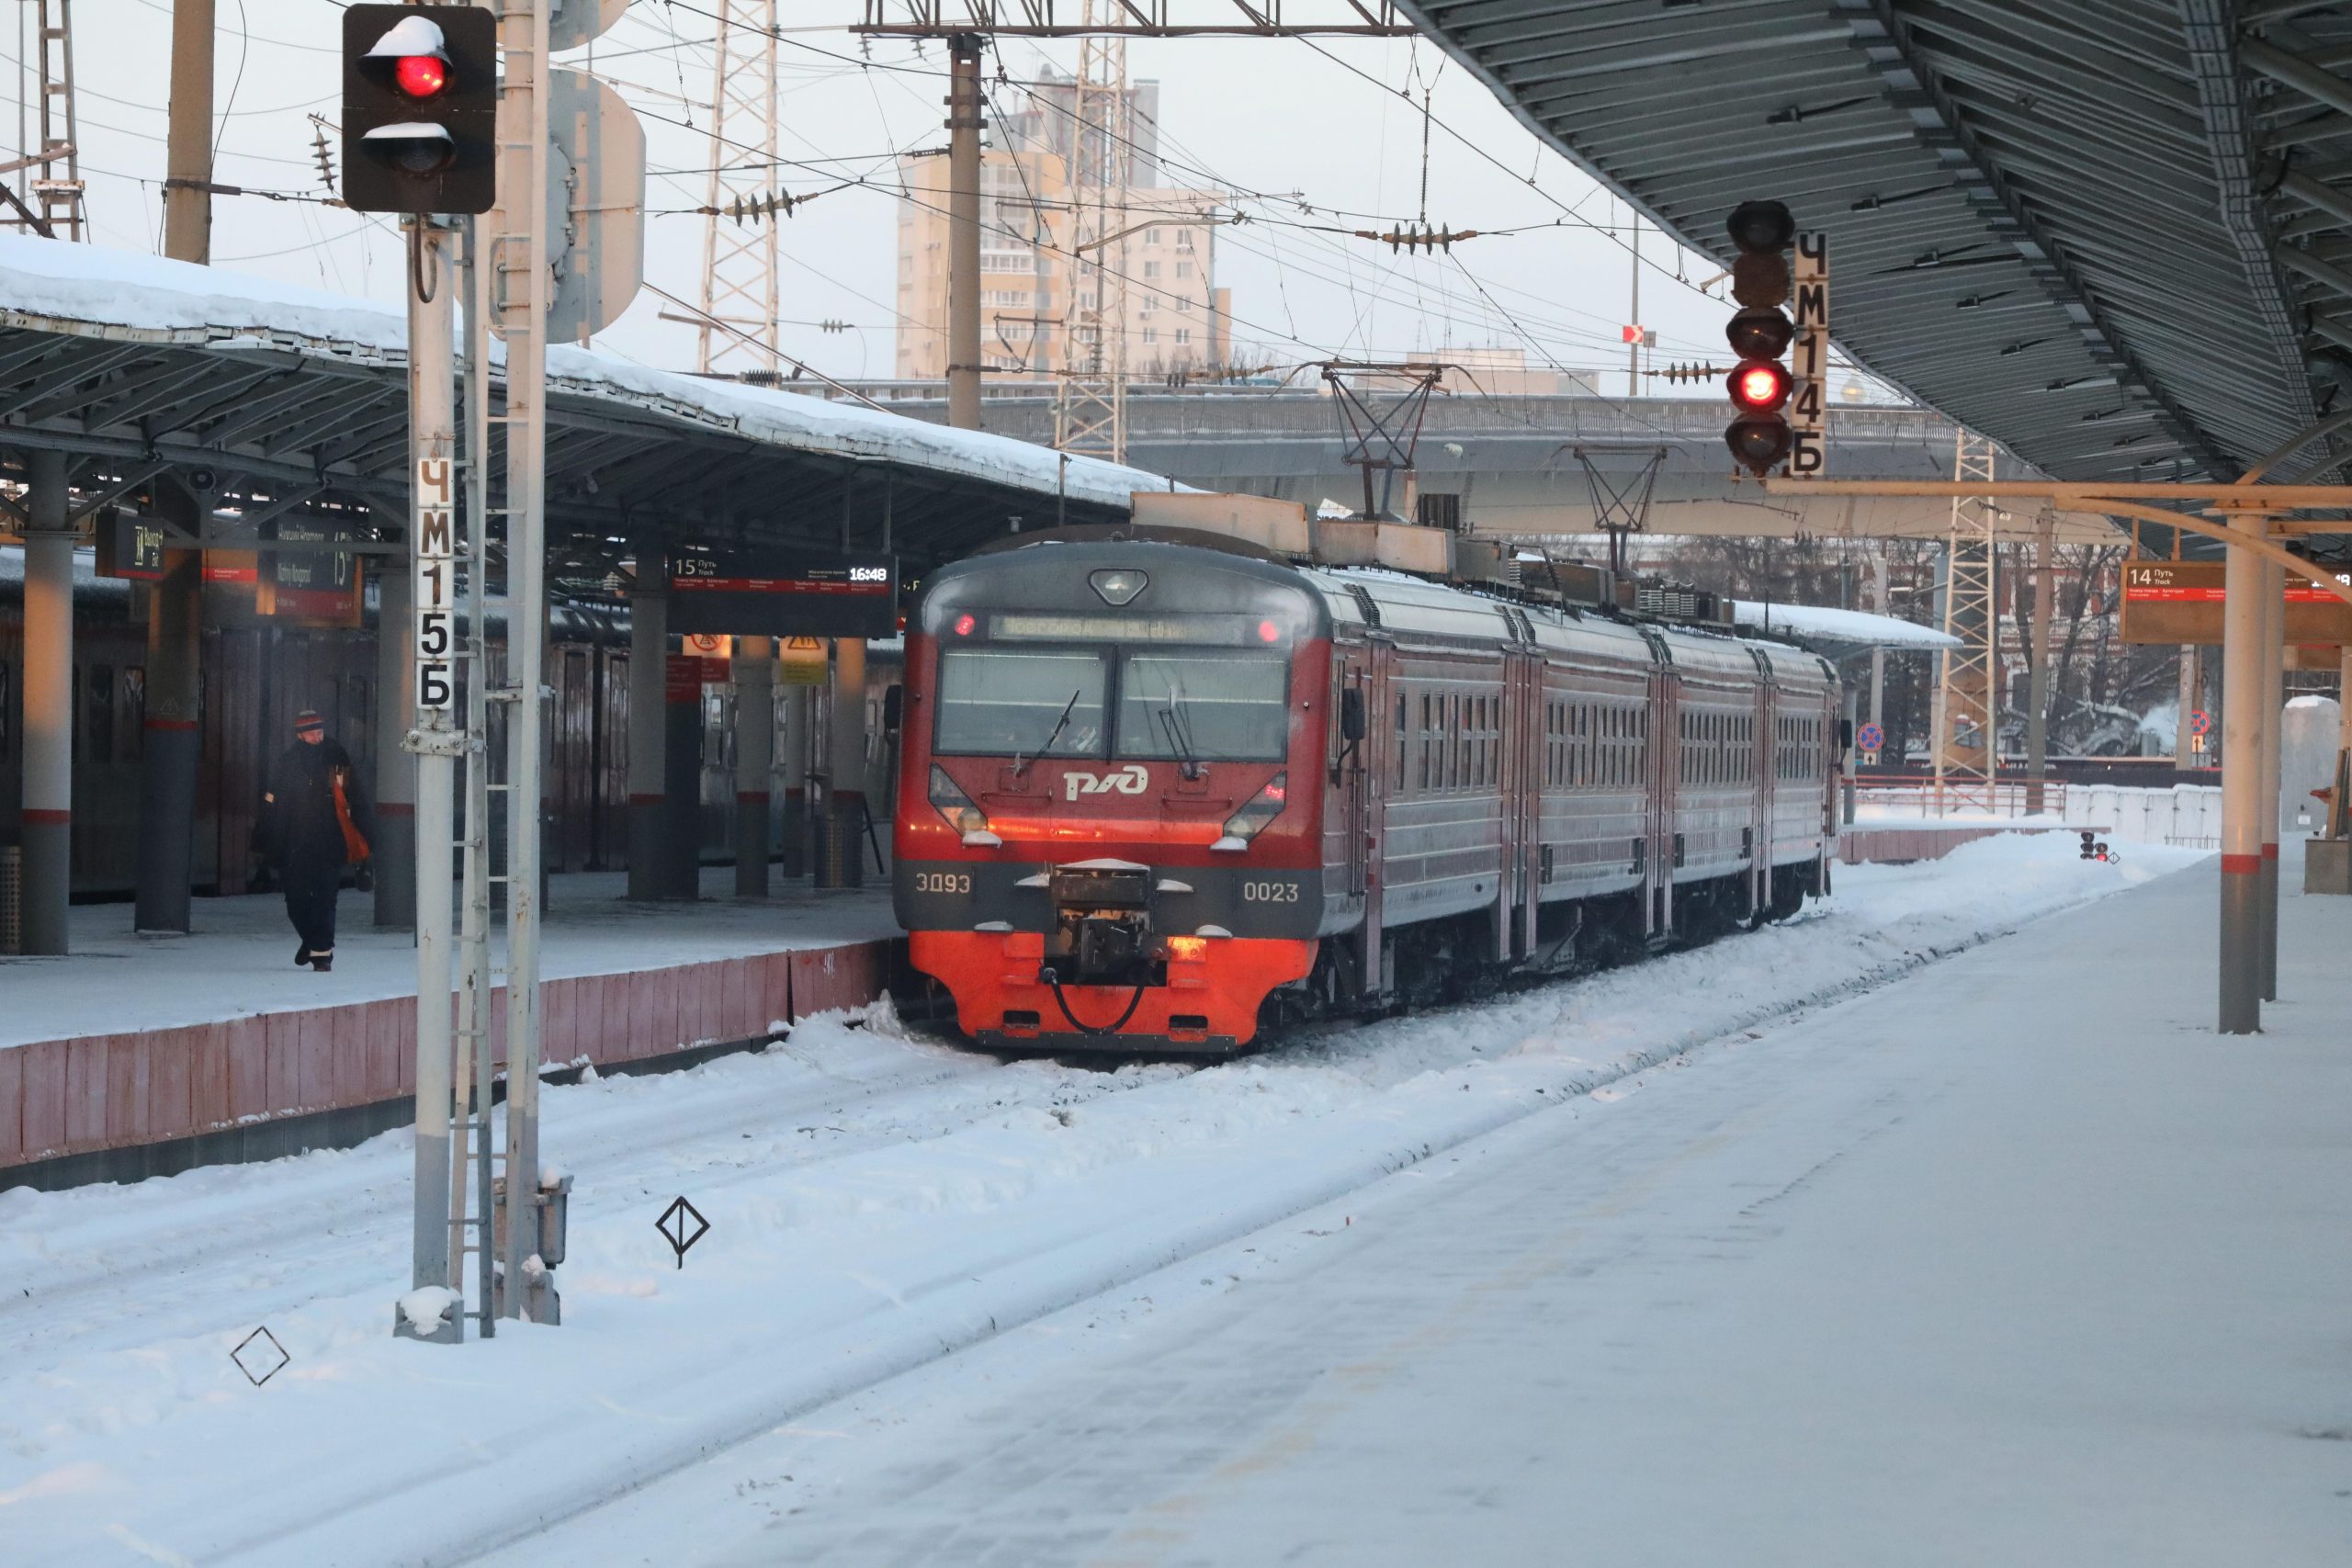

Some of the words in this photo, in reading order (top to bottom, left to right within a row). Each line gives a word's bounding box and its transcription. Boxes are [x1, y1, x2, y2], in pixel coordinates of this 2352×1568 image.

[1794, 233, 1826, 472] ЧМ14Б
[676, 558, 695, 576] 15
[698, 560, 717, 569] Путь
[421, 460, 450, 705] ЧМ15Б
[850, 568, 887, 581] 16:48
[2131, 569, 2152, 585] 14
[2154, 570, 2174, 578] Путь
[1244, 882, 1298, 903] 0023
